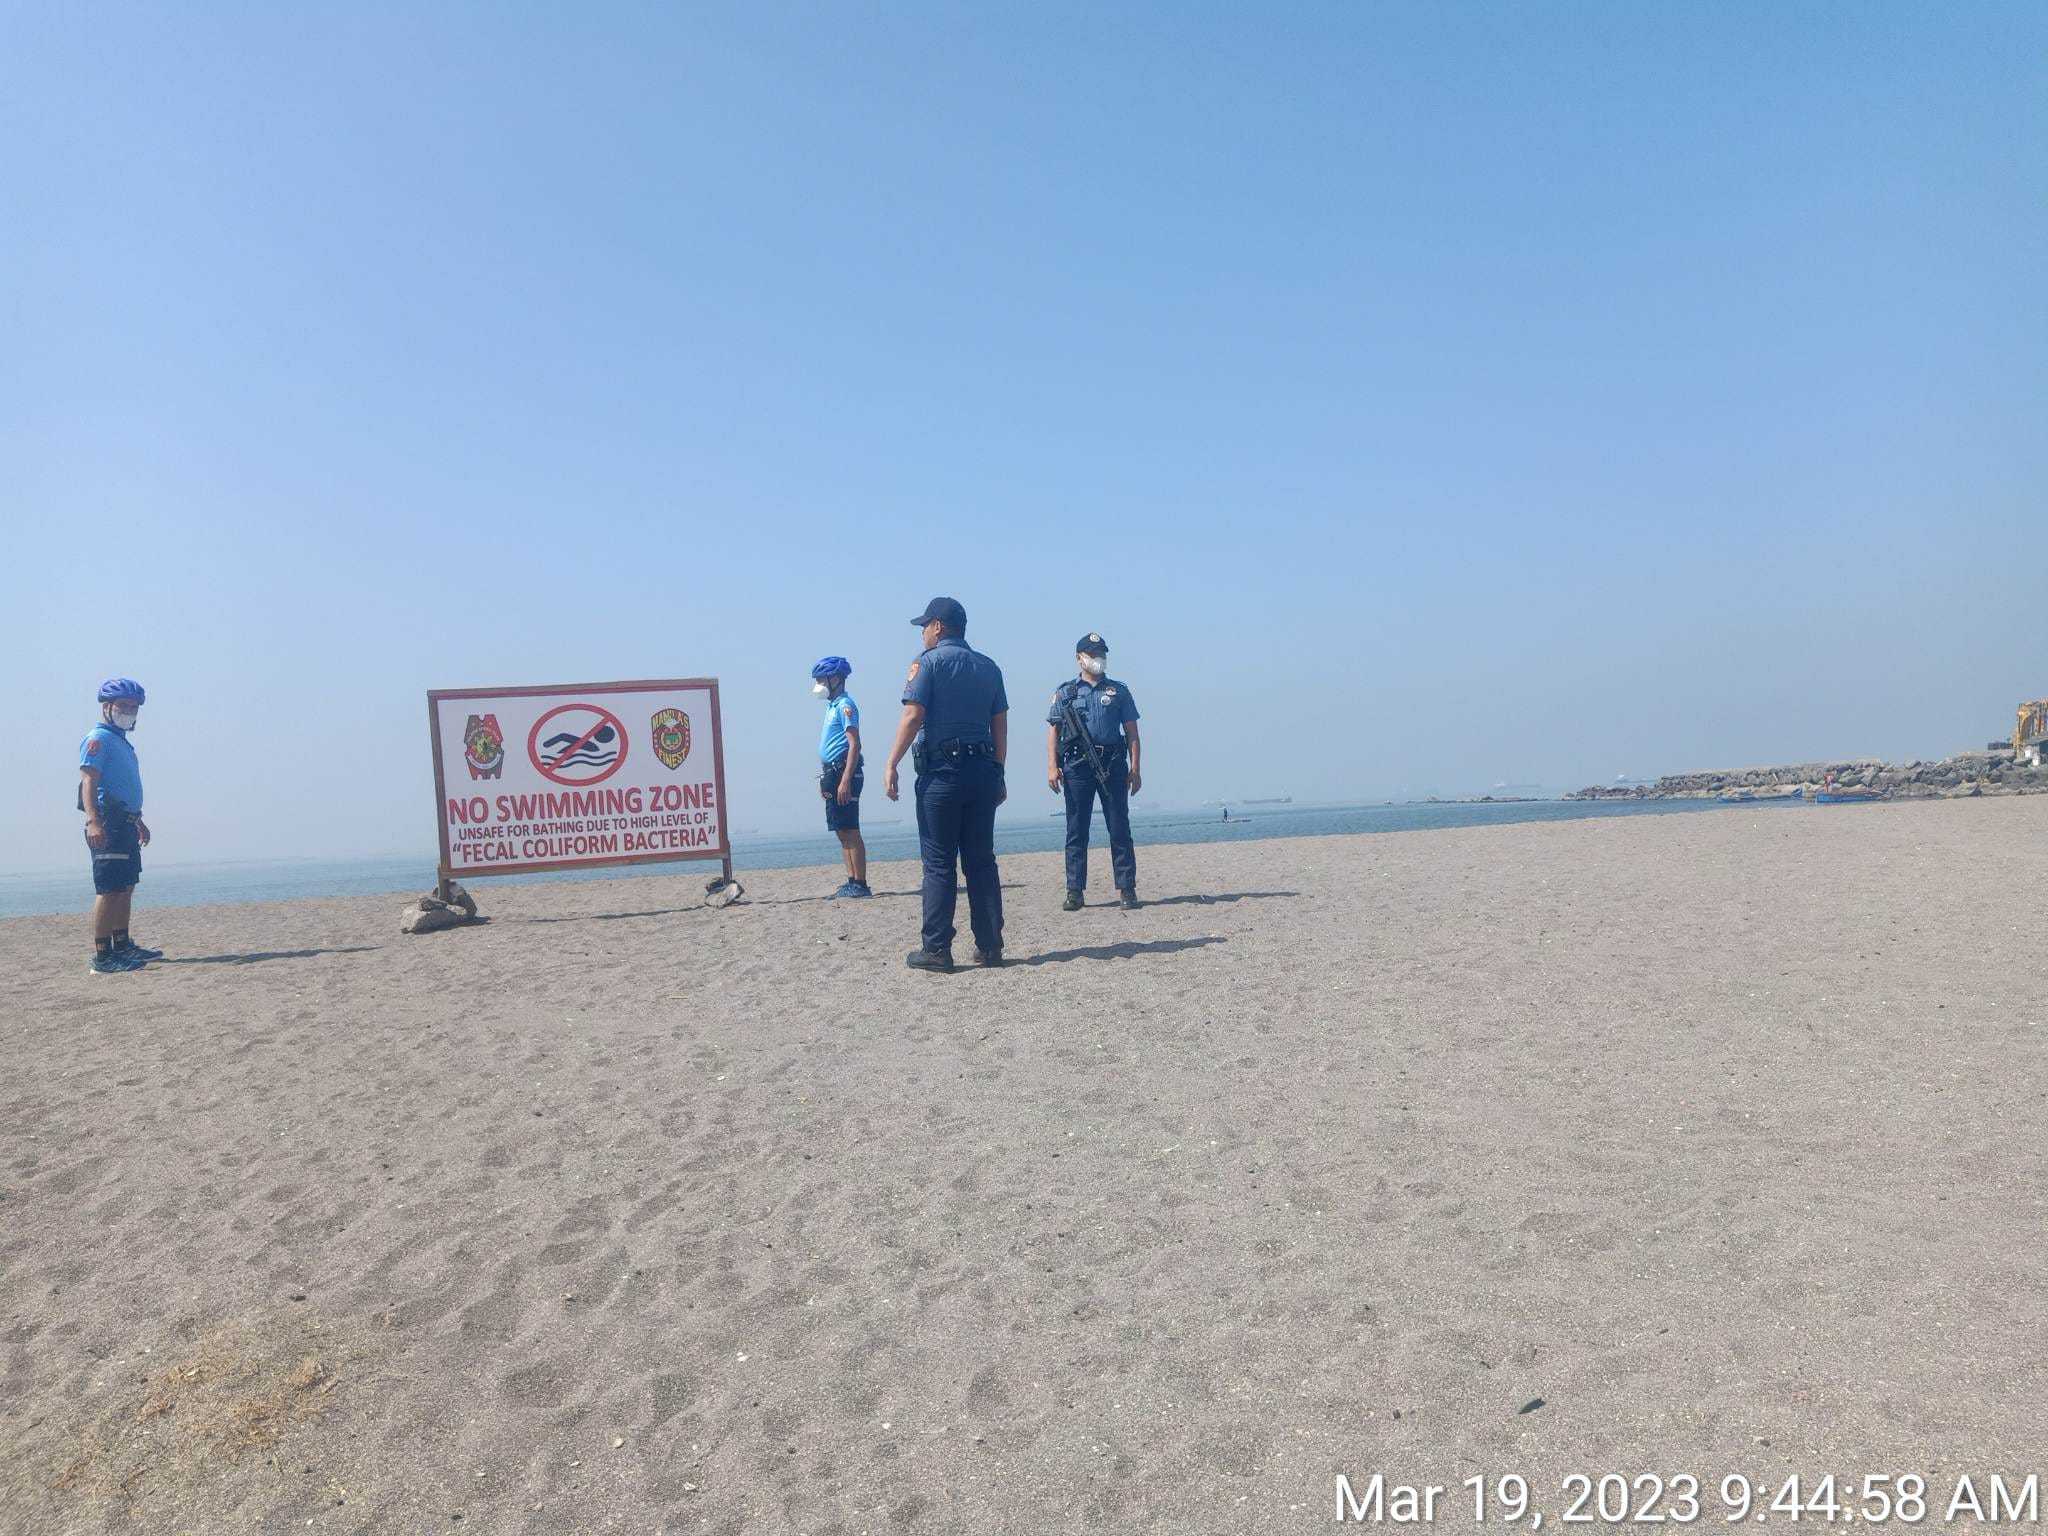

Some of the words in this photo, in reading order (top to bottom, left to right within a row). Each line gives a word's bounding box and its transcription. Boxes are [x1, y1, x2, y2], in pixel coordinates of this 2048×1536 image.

[449, 796, 489, 824] NO
[496, 788, 642, 822] SWIMMING
[649, 783, 714, 812] ZONE
[459, 826, 504, 841] UNSAFE
[506, 824, 530, 838] FOR
[532, 821, 583, 836] BATHING
[586, 819, 610, 832] DUE
[612, 818, 628, 829] TO
[630, 816, 658, 828] HIGH
[661, 814, 692, 826] LEVEL
[694, 812, 709, 824] OF
[524, 833, 618, 858] COLIFORM
